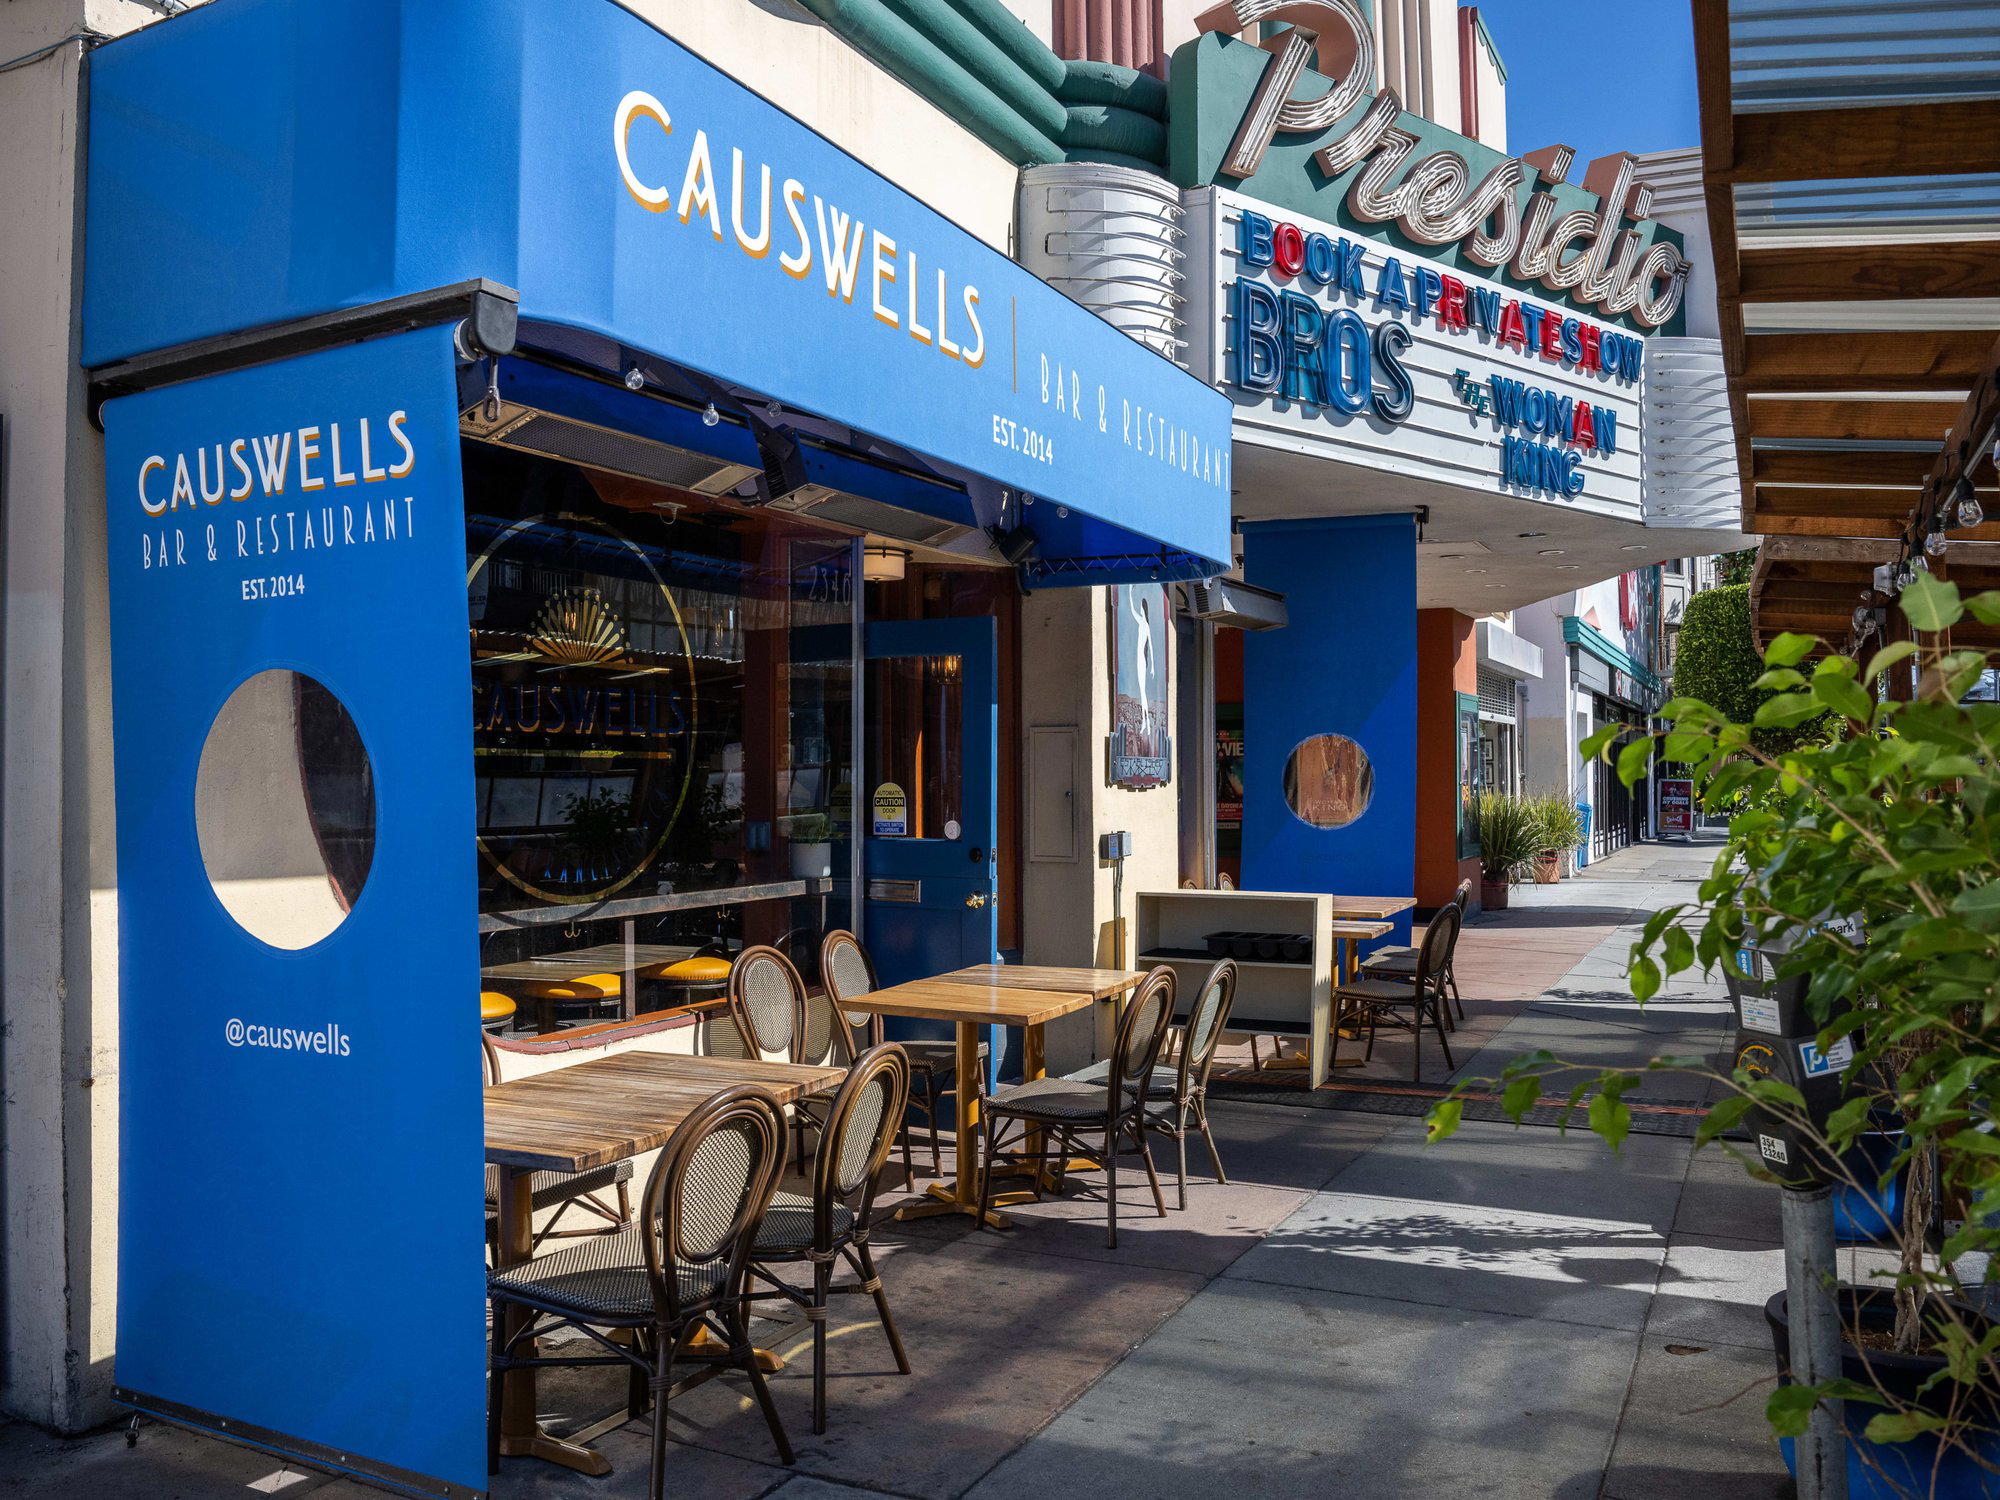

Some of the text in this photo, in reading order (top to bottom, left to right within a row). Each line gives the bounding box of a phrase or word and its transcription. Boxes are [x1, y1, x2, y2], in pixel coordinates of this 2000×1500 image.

[1194, 0, 1693, 327] Presidio
[613, 89, 985, 369] CAUSWELLS
[1242, 208, 1644, 383] BOOK A PRIVATE SHOW
[1235, 275, 1415, 425] BROS
[1040, 352, 1229, 492] BAR & RESTAURANT
[1455, 367, 1617, 455] THE WOMAN
[138, 410, 415, 518] CAUSWELLS
[1502, 434, 1586, 499] KING
[143, 496, 414, 570] BAR & RESTAURANT
[473, 679, 685, 736] AUSWELLS
[874, 798, 904, 806] CAUTION
[225, 1017, 351, 1057] @causwells
